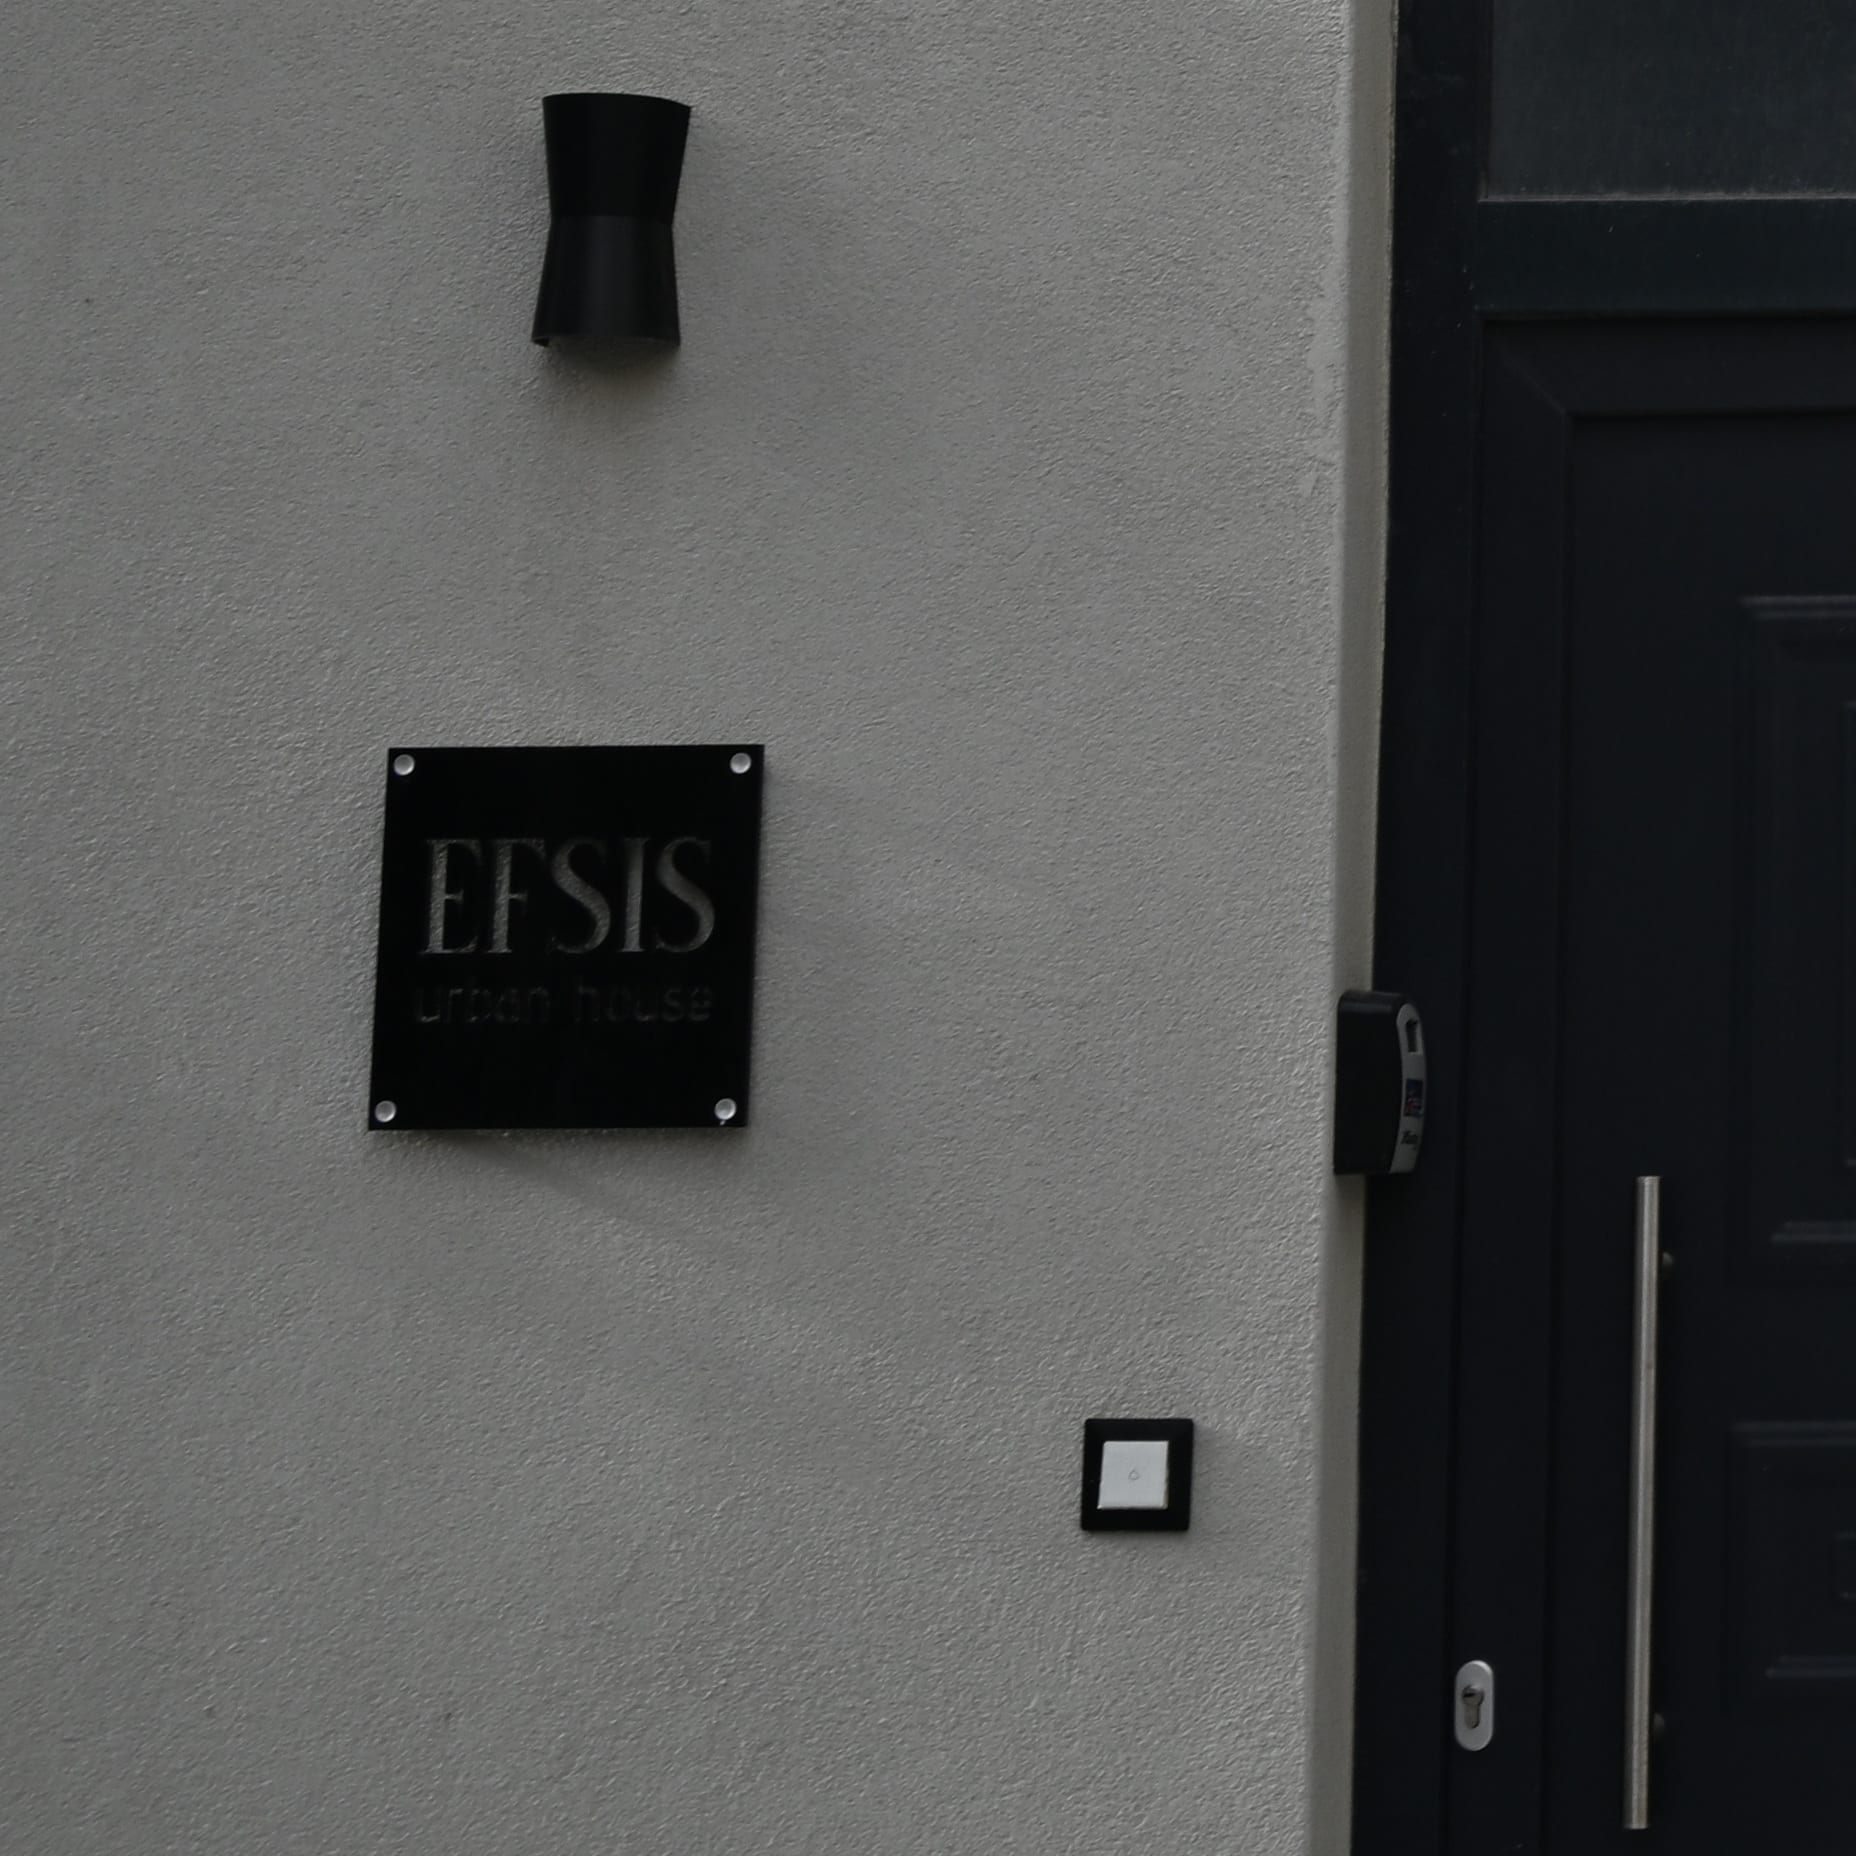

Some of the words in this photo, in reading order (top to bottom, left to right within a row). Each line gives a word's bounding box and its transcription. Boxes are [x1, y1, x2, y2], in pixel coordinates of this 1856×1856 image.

[416, 836, 716, 954] EFSIS
[416, 975, 551, 1025] urban
[575, 973, 714, 1024] house
